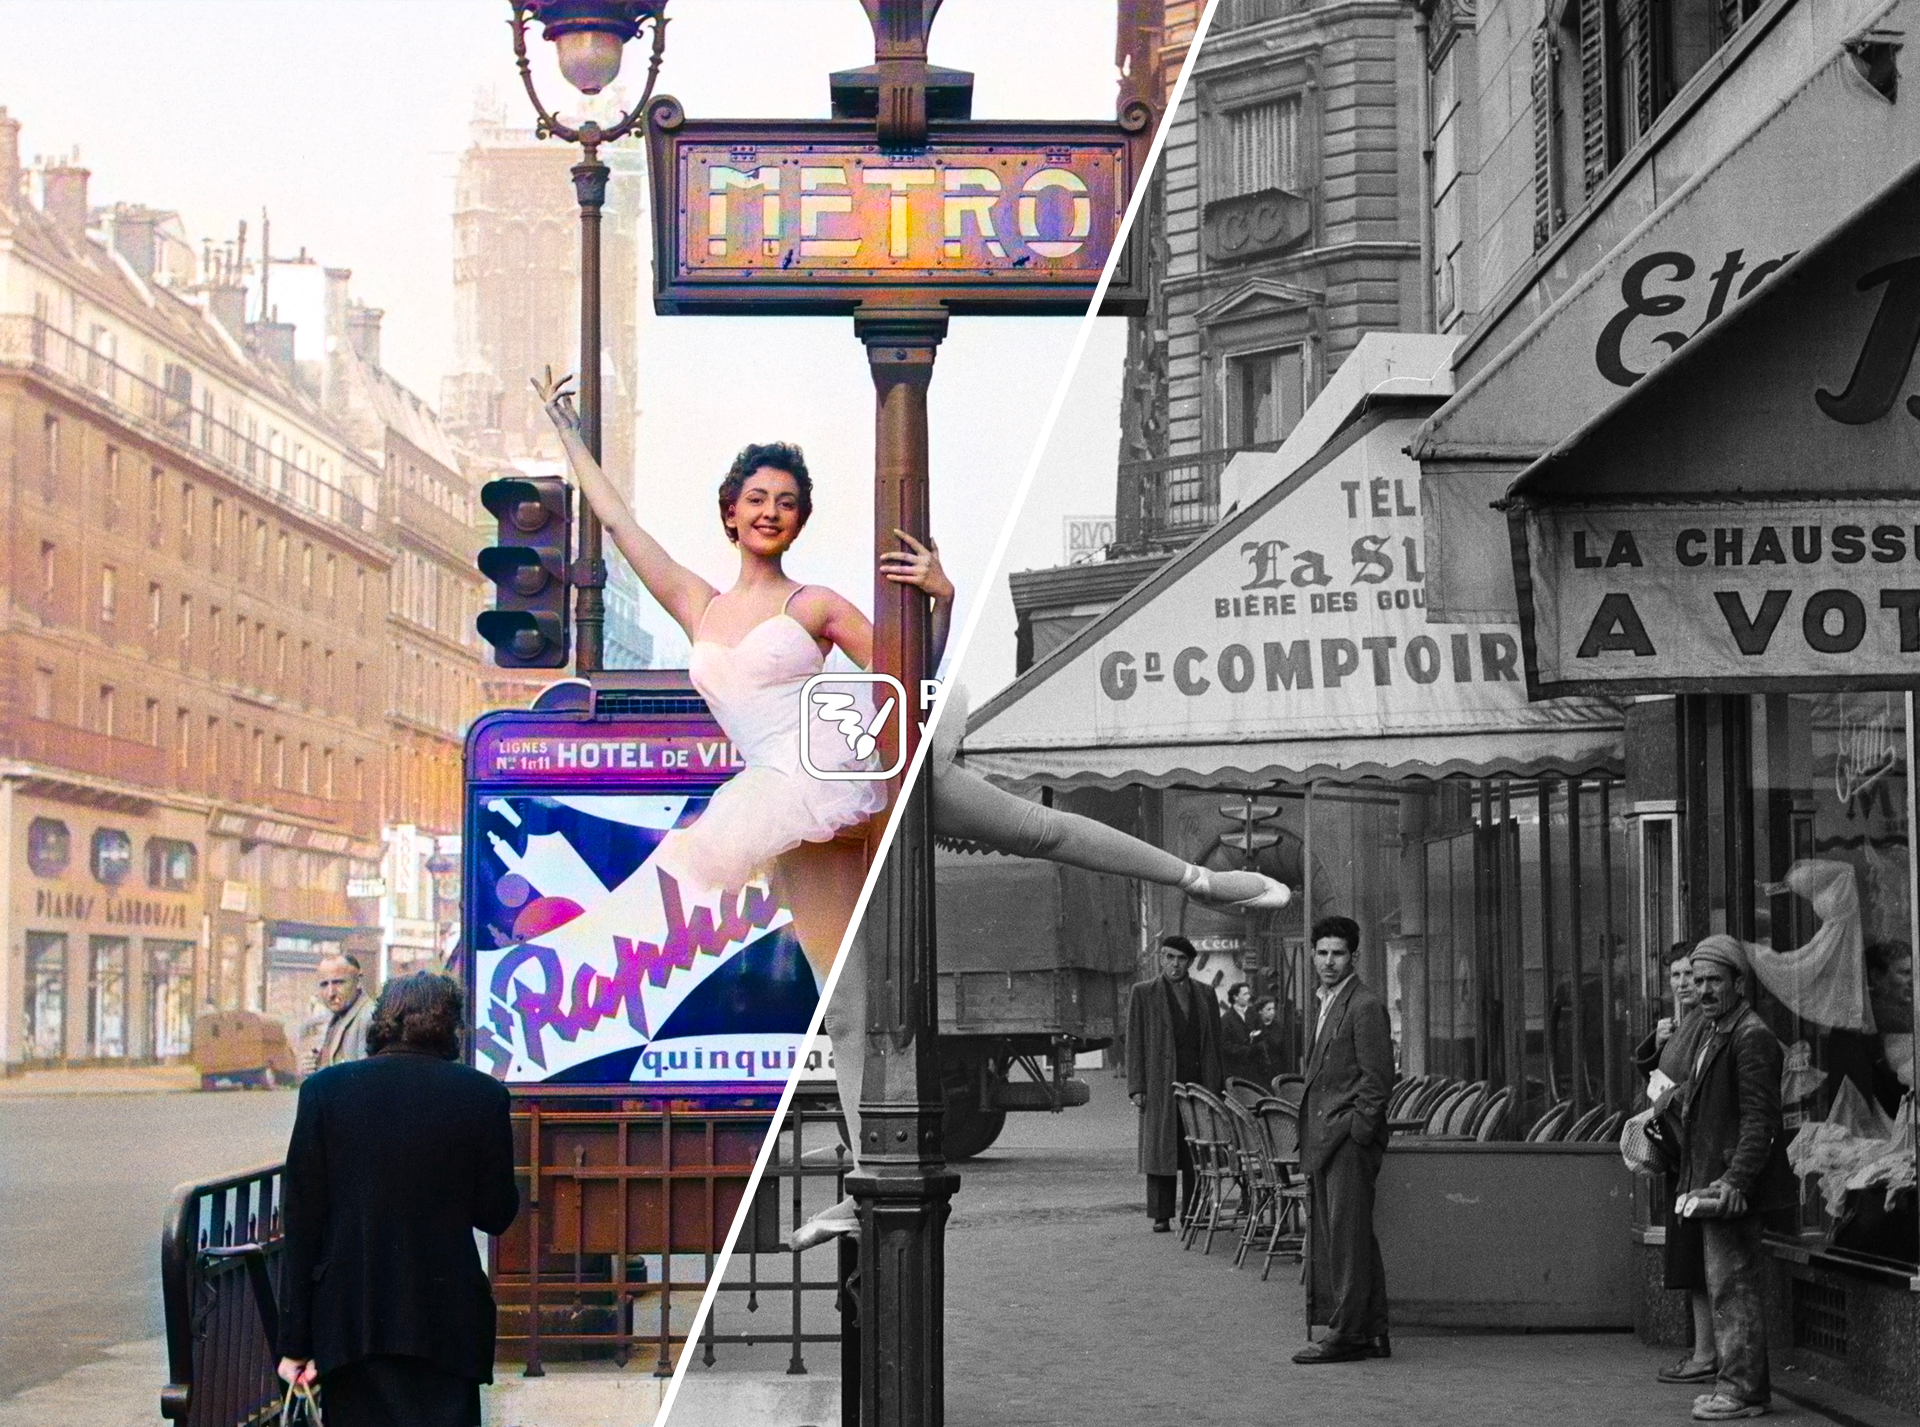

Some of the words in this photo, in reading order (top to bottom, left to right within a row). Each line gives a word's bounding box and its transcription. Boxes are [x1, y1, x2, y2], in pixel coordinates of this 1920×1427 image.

[708, 165, 1091, 258] METRO
[1240, 540, 1333, 590] La
[1573, 530, 1643, 568] LA
[1675, 525, 1920, 566] CHAUSS
[1310, 591, 1358, 613] DES
[1576, 593, 1657, 658] A
[1173, 632, 1521, 696] COMPTOIR
[500, 741, 548, 754] LIGNES
[557, 743, 653, 768] HOTEL
[662, 750, 689, 767] DE
